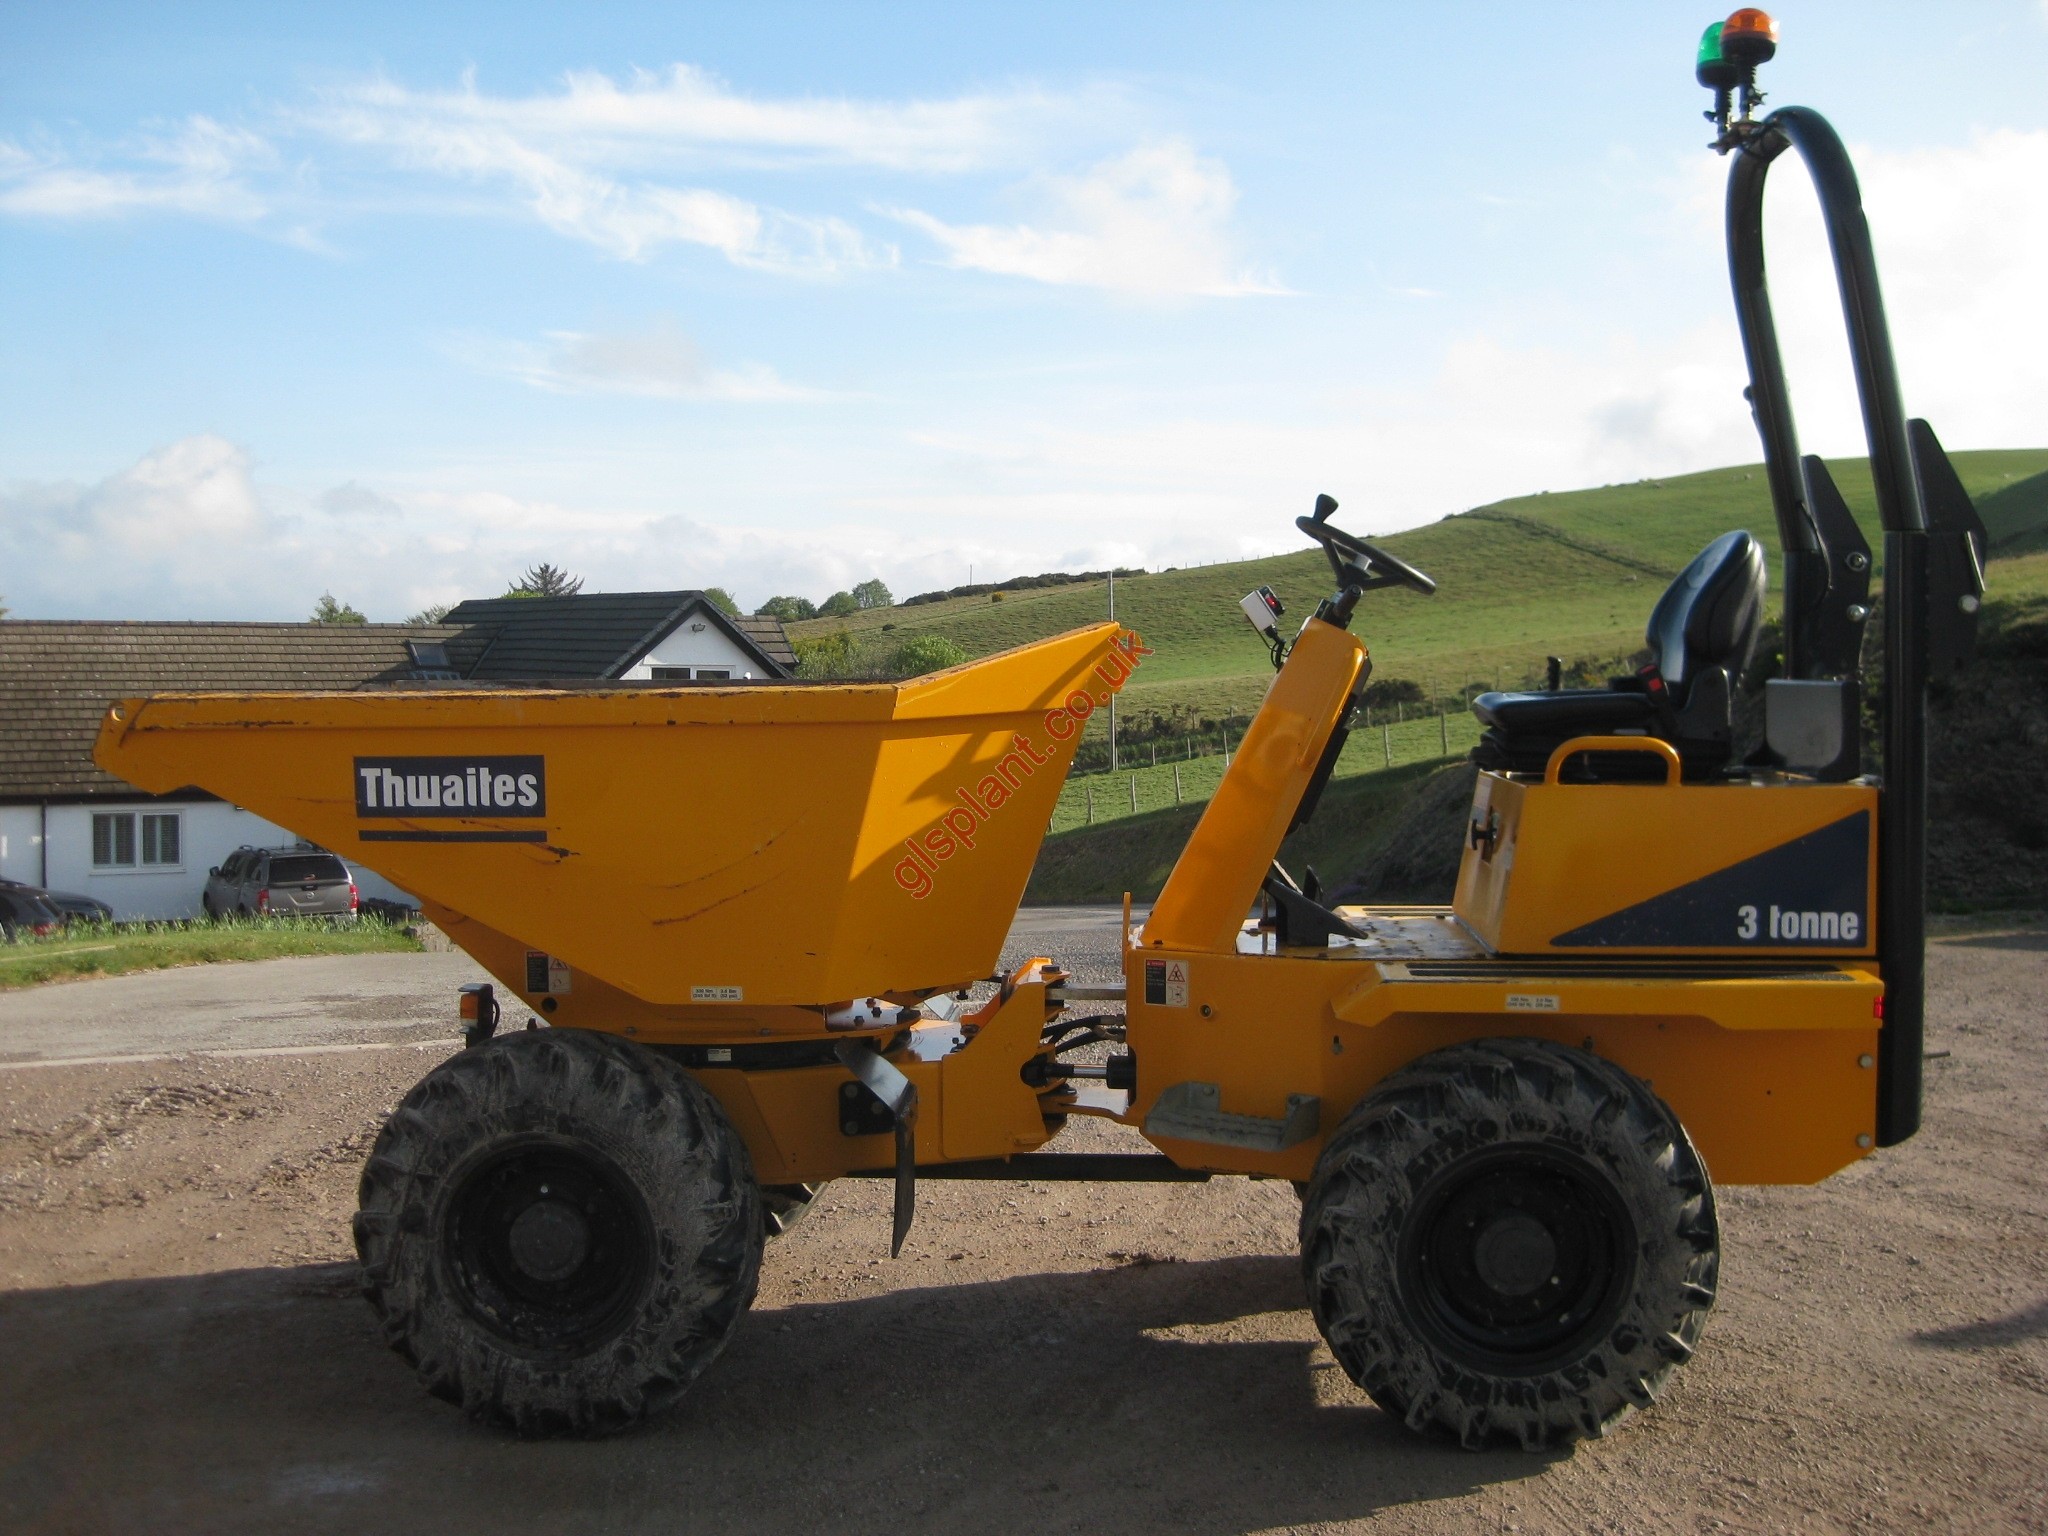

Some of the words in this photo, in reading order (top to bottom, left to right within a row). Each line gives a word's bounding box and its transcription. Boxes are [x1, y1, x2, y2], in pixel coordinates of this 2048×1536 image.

[360, 767, 538, 807] Thwaites
[1737, 905, 1758, 939] 3
[1769, 905, 1859, 940] tonne
